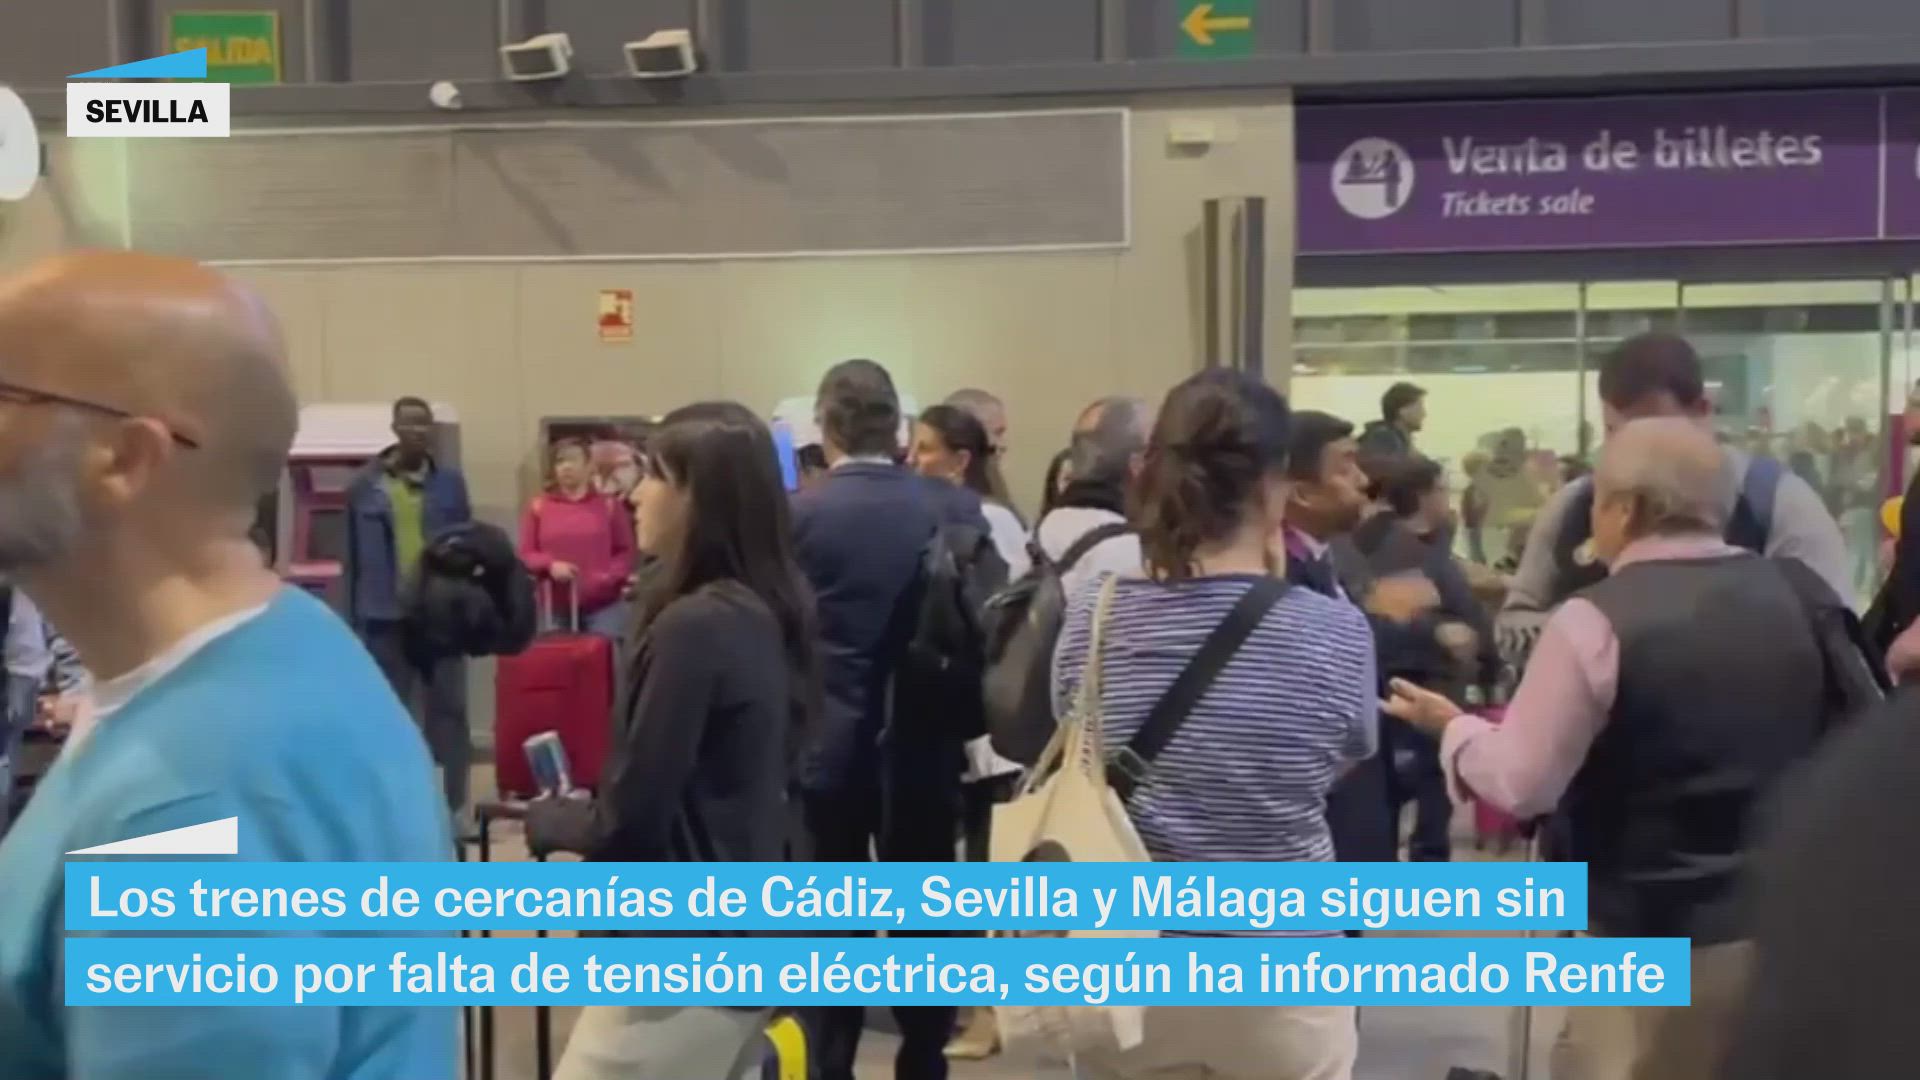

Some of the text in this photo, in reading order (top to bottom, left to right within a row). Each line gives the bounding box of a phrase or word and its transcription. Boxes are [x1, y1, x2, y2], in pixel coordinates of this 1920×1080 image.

[1442, 126, 1822, 175] Venta de billetes
[1442, 188, 1595, 217] Tickets sale
